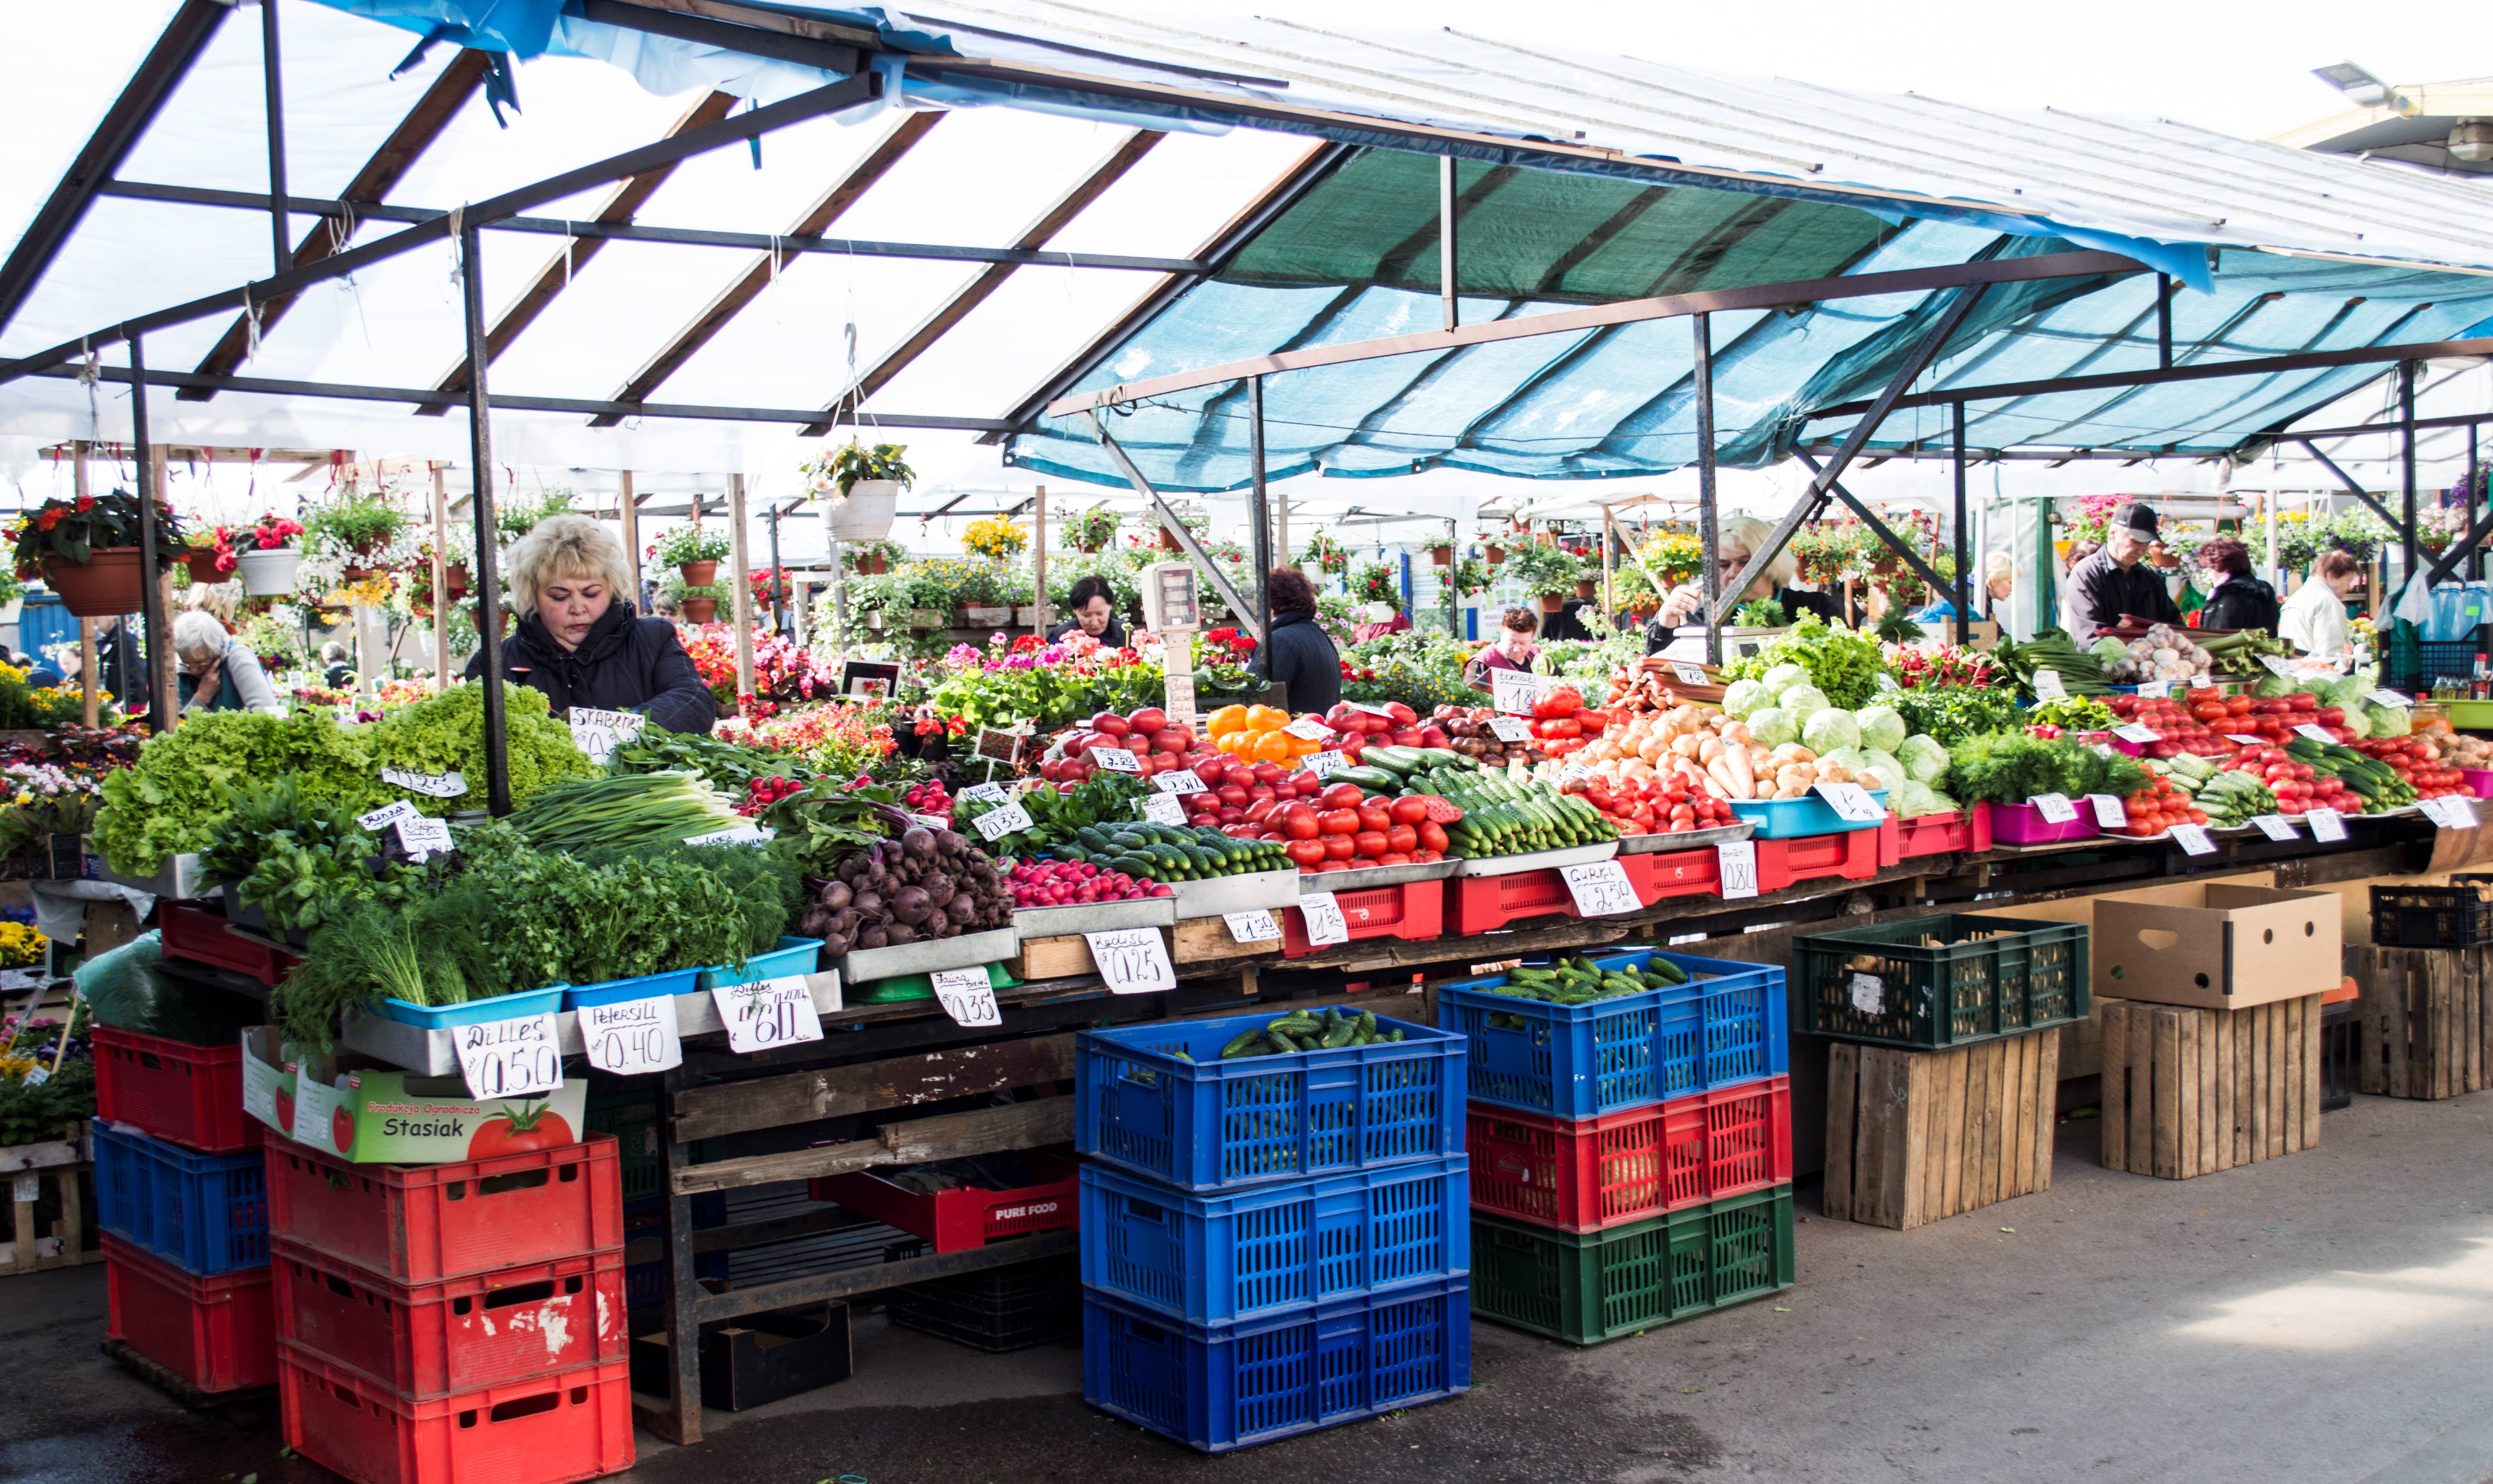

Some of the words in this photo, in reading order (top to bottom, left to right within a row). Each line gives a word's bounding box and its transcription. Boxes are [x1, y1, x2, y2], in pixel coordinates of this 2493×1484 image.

[368, 1101, 420, 1115] Produkcja
[423, 1104, 481, 1116] Ogrodnicza
[383, 1118, 464, 1137] Stasiak
[995, 1206, 1026, 1220] PURE
[1028, 1202, 1058, 1215] FOOD
